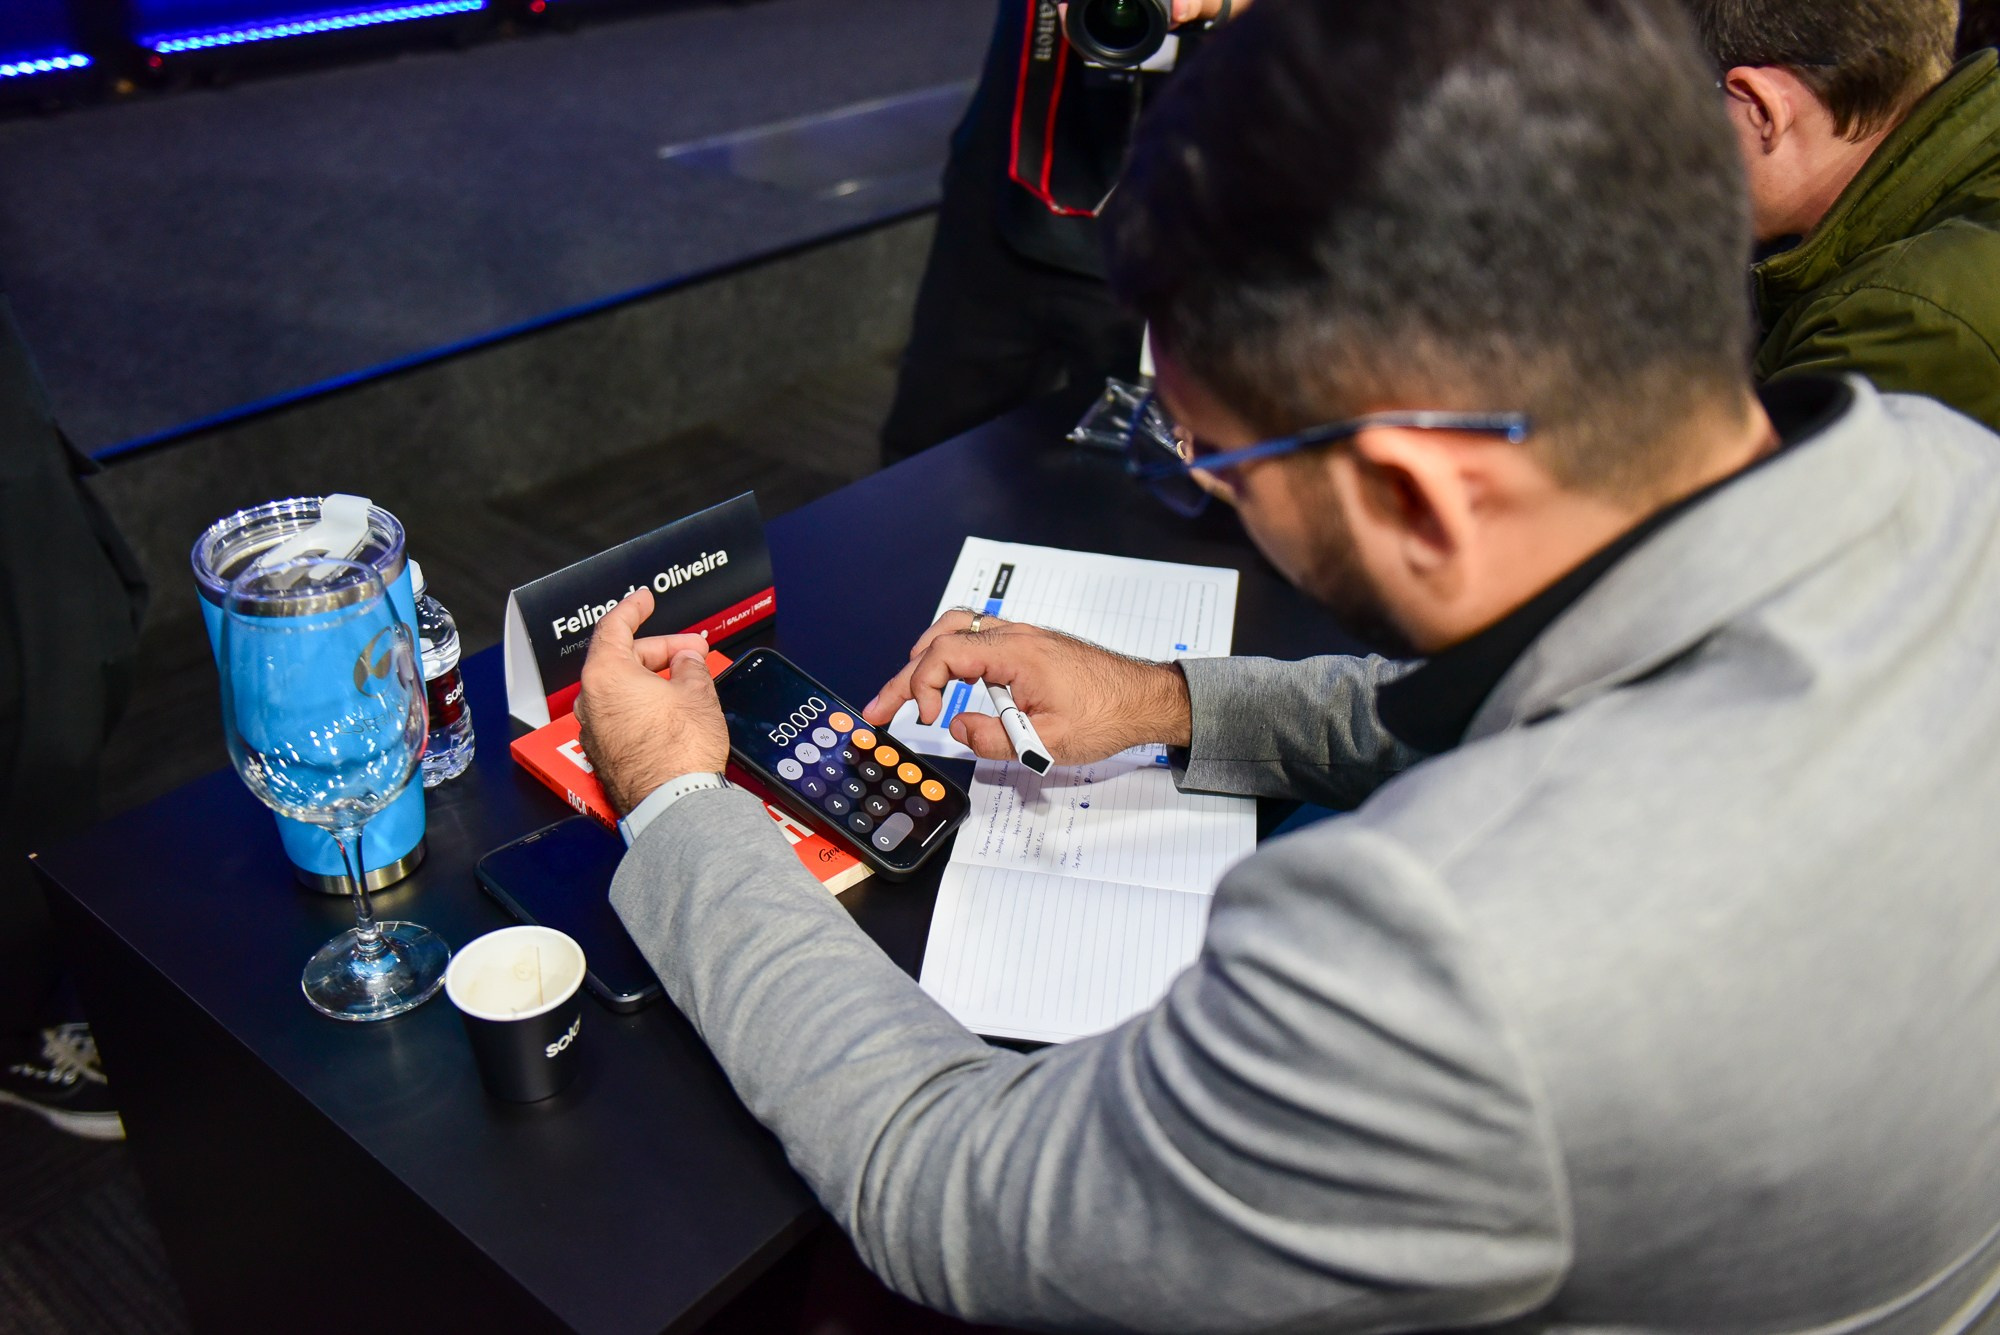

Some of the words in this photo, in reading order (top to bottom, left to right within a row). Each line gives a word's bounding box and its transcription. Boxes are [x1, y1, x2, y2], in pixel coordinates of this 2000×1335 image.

[1034, 0, 1056, 61] anon
[653, 550, 729, 593] Oliveira
[727, 609, 750, 625] GALAXY
[768, 696, 827, 747] 50.000
[786, 765, 794, 773] C
[808, 782, 817, 792] 7
[826, 766, 836, 775] 8
[842, 750, 852, 759] 9
[833, 799, 842, 809] 4
[849, 783, 859, 792] 5
[866, 767, 876, 776] 6
[856, 818, 866, 826] 1
[872, 801, 883, 810] 2
[889, 785, 899, 794] 3
[880, 836, 890, 845] 0
